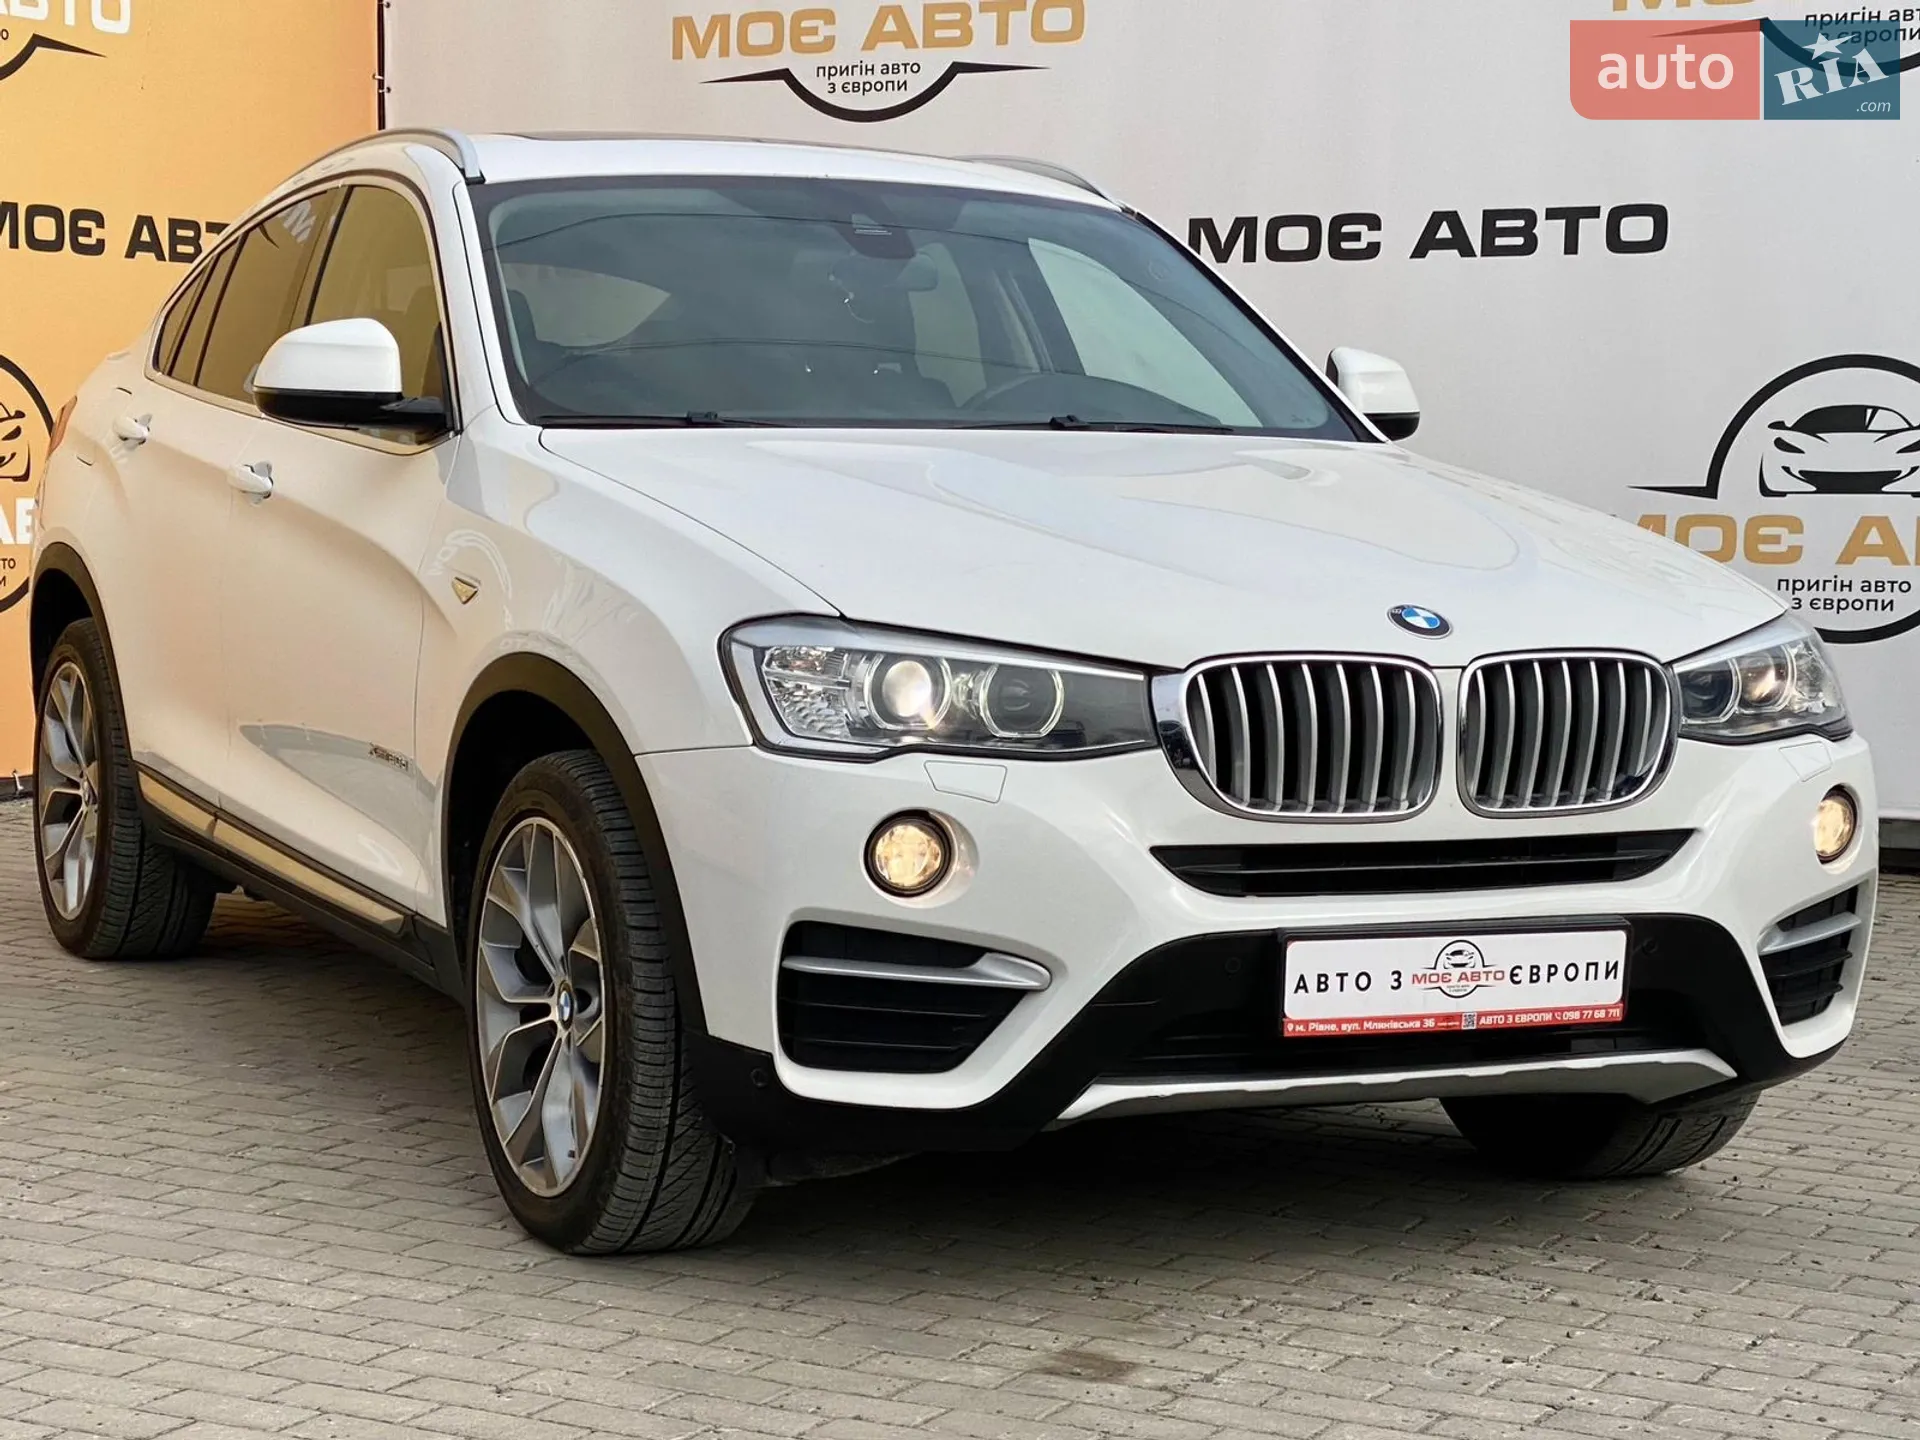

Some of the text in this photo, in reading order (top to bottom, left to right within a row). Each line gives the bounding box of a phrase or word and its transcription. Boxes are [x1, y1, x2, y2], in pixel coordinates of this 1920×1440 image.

[1804, 6, 1881, 30] пригін
[672, 0, 1086, 60] МОЄ АВТО
[815, 60, 921, 80] пригін авто
[841, 79, 908, 97] європи
[1188, 203, 1668, 263] МОЄ АВТО
[1776, 575, 1911, 596] пригін авто
[1809, 597, 1894, 614] європи
[1293, 971, 1372, 994] АВТО
[1510, 960, 1619, 985] ЄВРОПИ
[1412, 970, 1505, 984] МОЄ АВТО
[1479, 1014, 1505, 1025] АВТО
[1515, 1012, 1552, 1023] ЄВРОПИ
